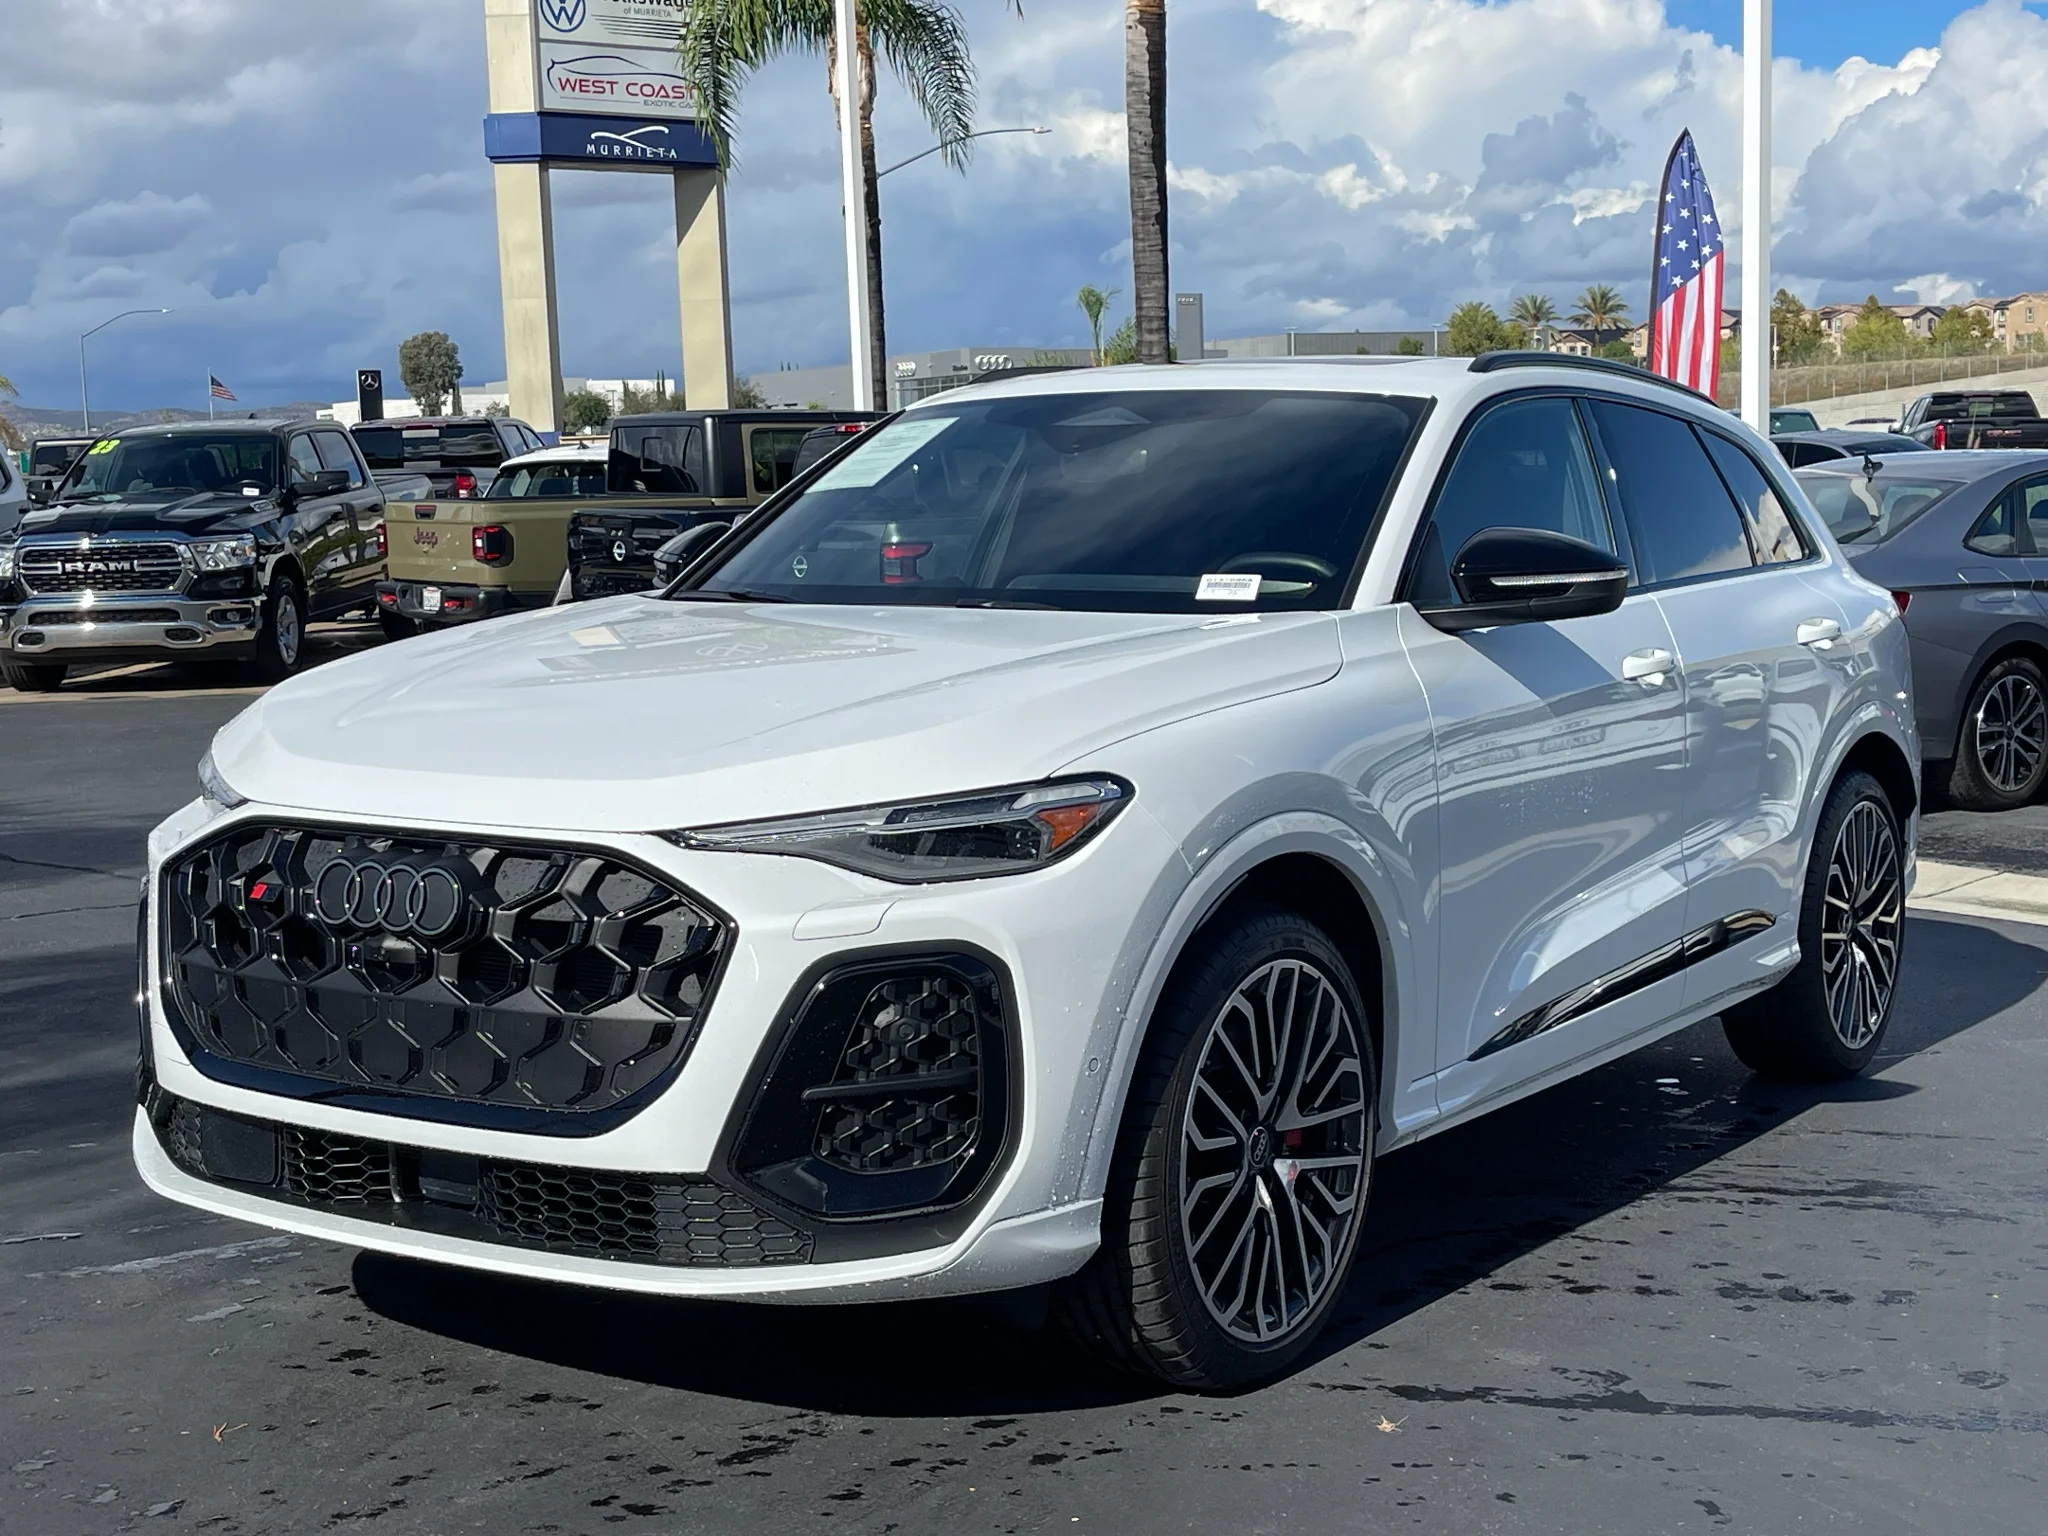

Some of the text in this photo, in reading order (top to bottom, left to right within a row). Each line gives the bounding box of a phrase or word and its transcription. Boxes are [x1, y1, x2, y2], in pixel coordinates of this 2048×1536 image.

[623, 7, 672, 18] of MURRIETA
[558, 77, 700, 100] WEST COAST
[643, 99, 677, 108] EXOTIC
[586, 144, 678, 159] MURRIETA
[414, 527, 439, 549] Jeep
[64, 561, 131, 573] RAM
